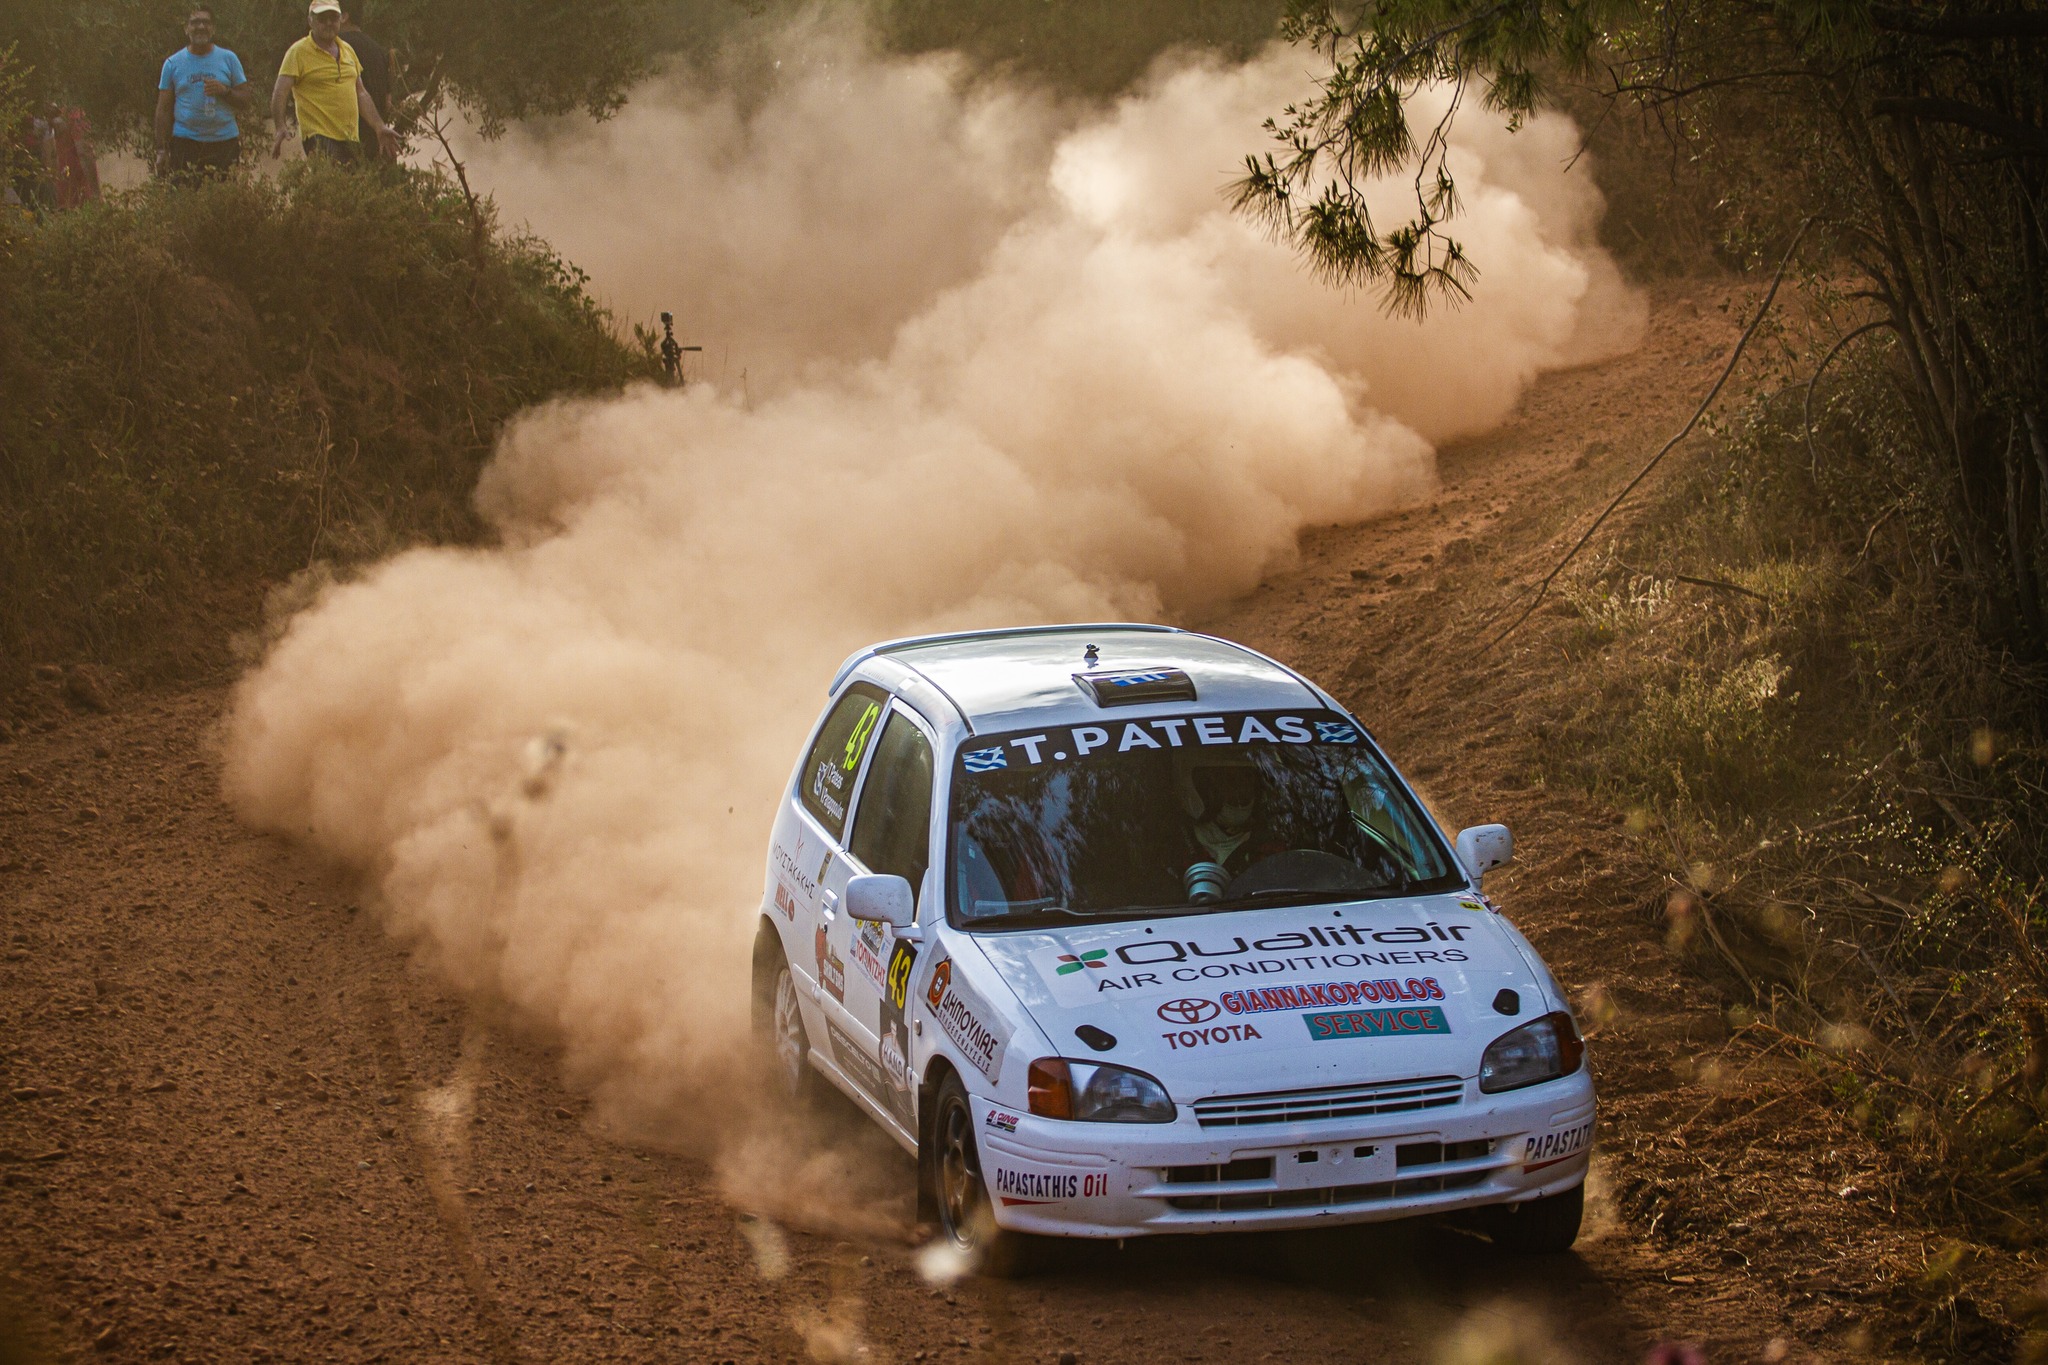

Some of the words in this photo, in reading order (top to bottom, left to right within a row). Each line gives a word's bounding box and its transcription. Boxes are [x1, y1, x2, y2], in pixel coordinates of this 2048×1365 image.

[842, 702, 880, 771] 43
[1115, 922, 1473, 966] Qualitair
[888, 947, 911, 1010] 43
[1096, 972, 1163, 993] AIR
[1171, 948, 1470, 981] CONDITIONERS
[1219, 977, 1446, 1015] GIANNAKOPOULOS
[1161, 1023, 1262, 1050] TOYOTA
[1312, 1009, 1438, 1036] SERVICE
[996, 1167, 1078, 1198] PAPASTATHIS
[1083, 1173, 1108, 1197] Oil
